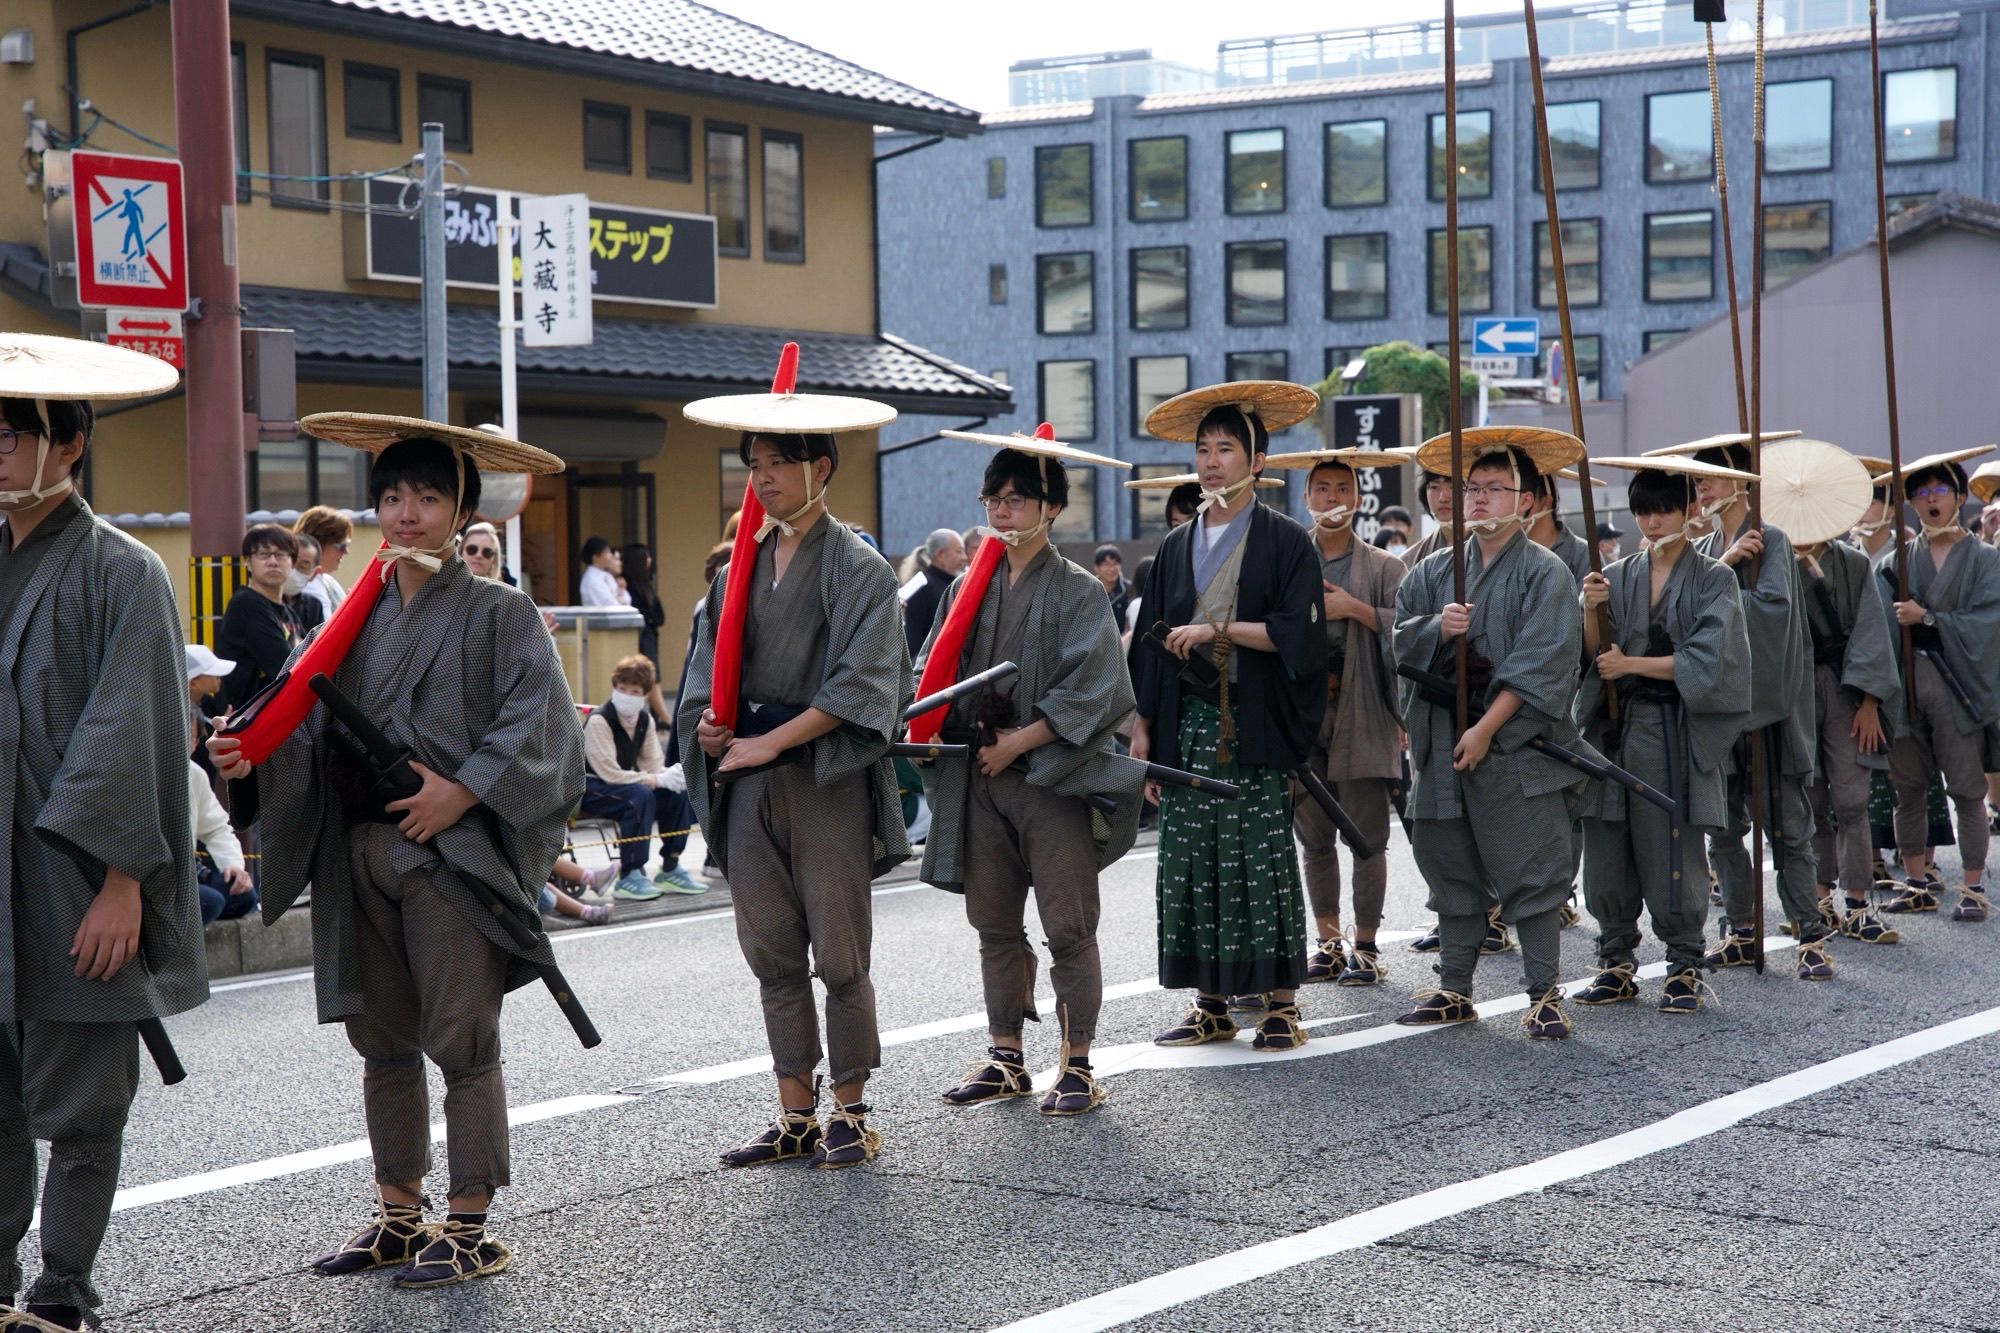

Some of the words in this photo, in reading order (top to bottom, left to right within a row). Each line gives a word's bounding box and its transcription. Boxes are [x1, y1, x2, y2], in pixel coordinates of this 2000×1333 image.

[588, 218, 673, 264] ステップ
[99, 260, 151, 284] 横断禁止
